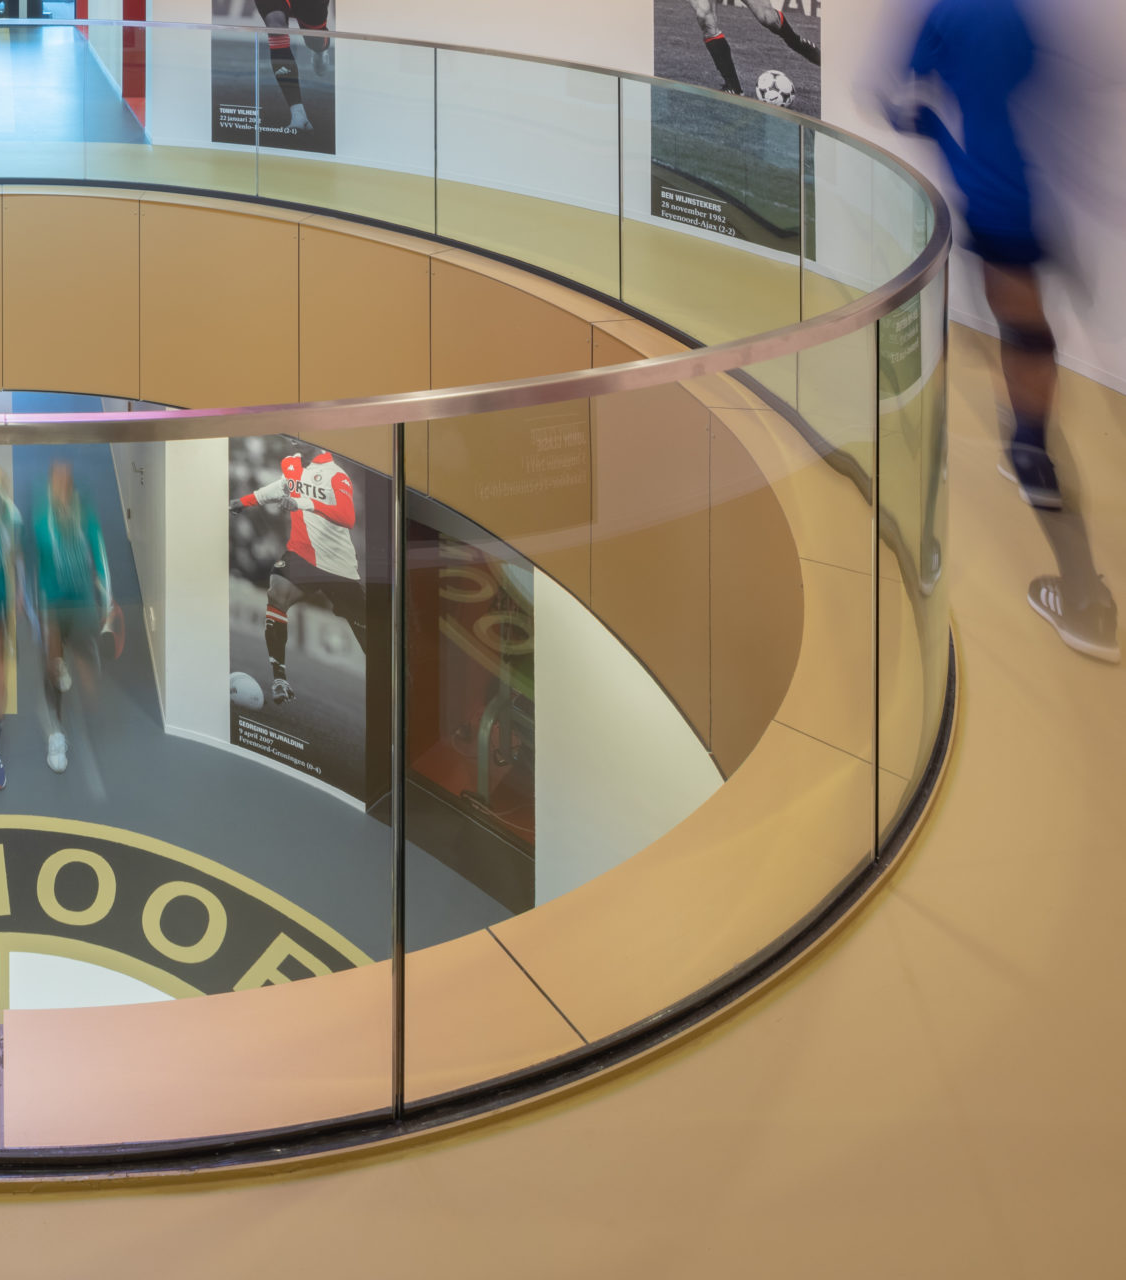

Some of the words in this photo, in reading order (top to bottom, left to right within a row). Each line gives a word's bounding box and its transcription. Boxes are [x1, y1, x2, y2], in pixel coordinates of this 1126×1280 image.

[227, 115, 248, 123] januari
[284, 127, 298, 135] (2-1)
[661, 191, 674, 200] BEN
[675, 194, 722, 213] WIJNSTEKERS
[661, 200, 670, 209] 28
[670, 204, 707, 218] november
[709, 213, 727, 224] 1982
[661, 210, 718, 231] Feyenoord-Ajax
[718, 225, 736, 236] (2-2)
[287, 479, 327, 500] ORTIS
[243, 730, 259, 740] april
[259, 735, 274, 745] 2007
[269, 729, 304, 750] WIJNALDUM
[239, 735, 306, 767] Feyenoord-Groningen
[306, 762, 322, 775] (0-4)
